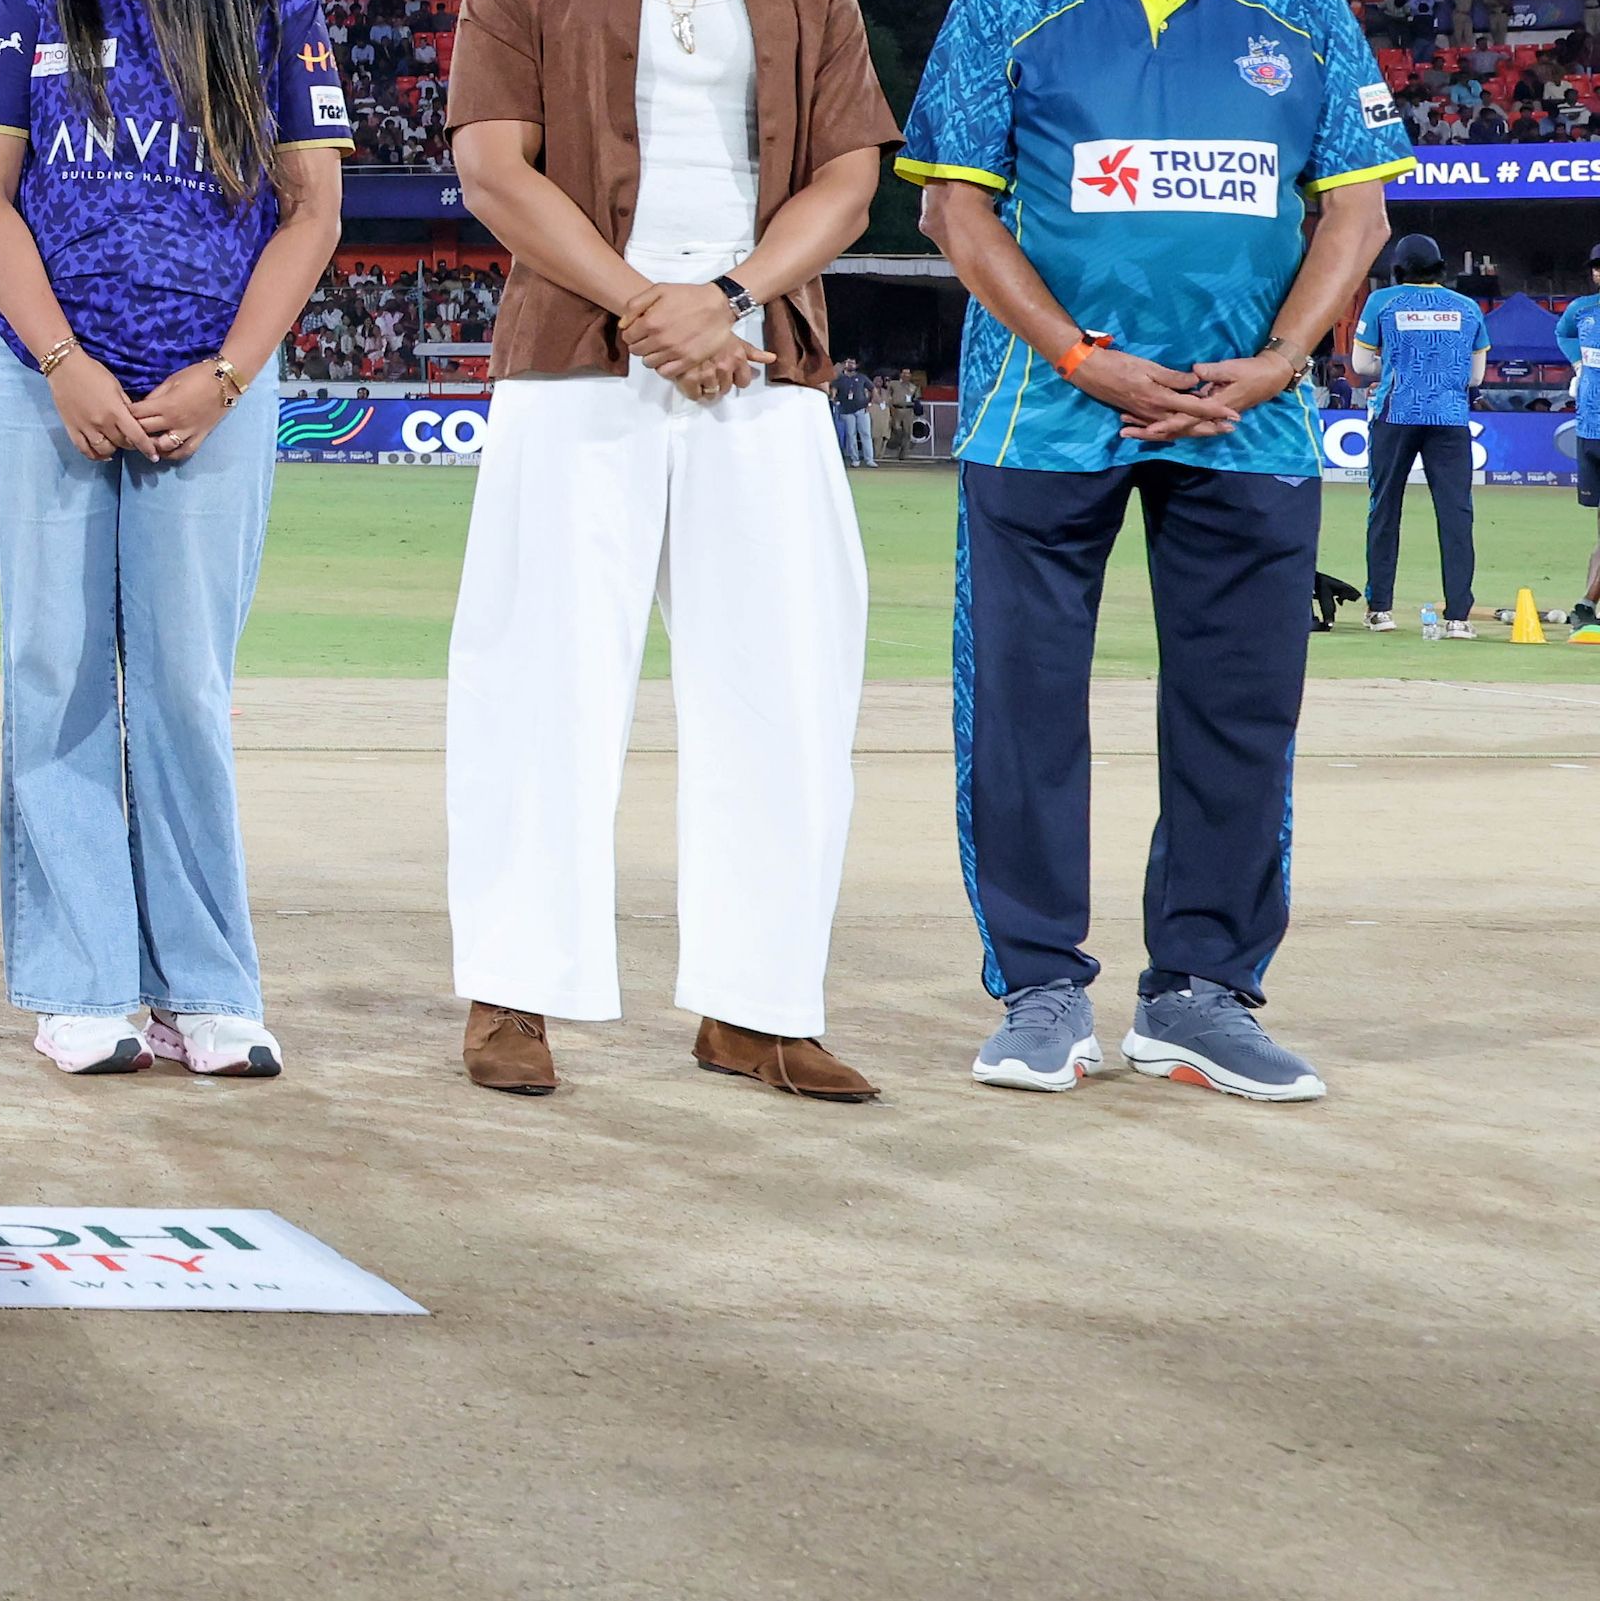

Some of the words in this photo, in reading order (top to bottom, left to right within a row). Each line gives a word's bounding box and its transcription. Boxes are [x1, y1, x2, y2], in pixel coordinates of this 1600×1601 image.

[1150, 150, 1275, 177] TRUZON
[62, 171, 134, 180] BUILDING
[143, 173, 225, 195] HAPPINESS
[1152, 177, 1257, 203] SOLAR
[1433, 314, 1458, 322] GBS
[71, 1280, 284, 1292] WITHIN
